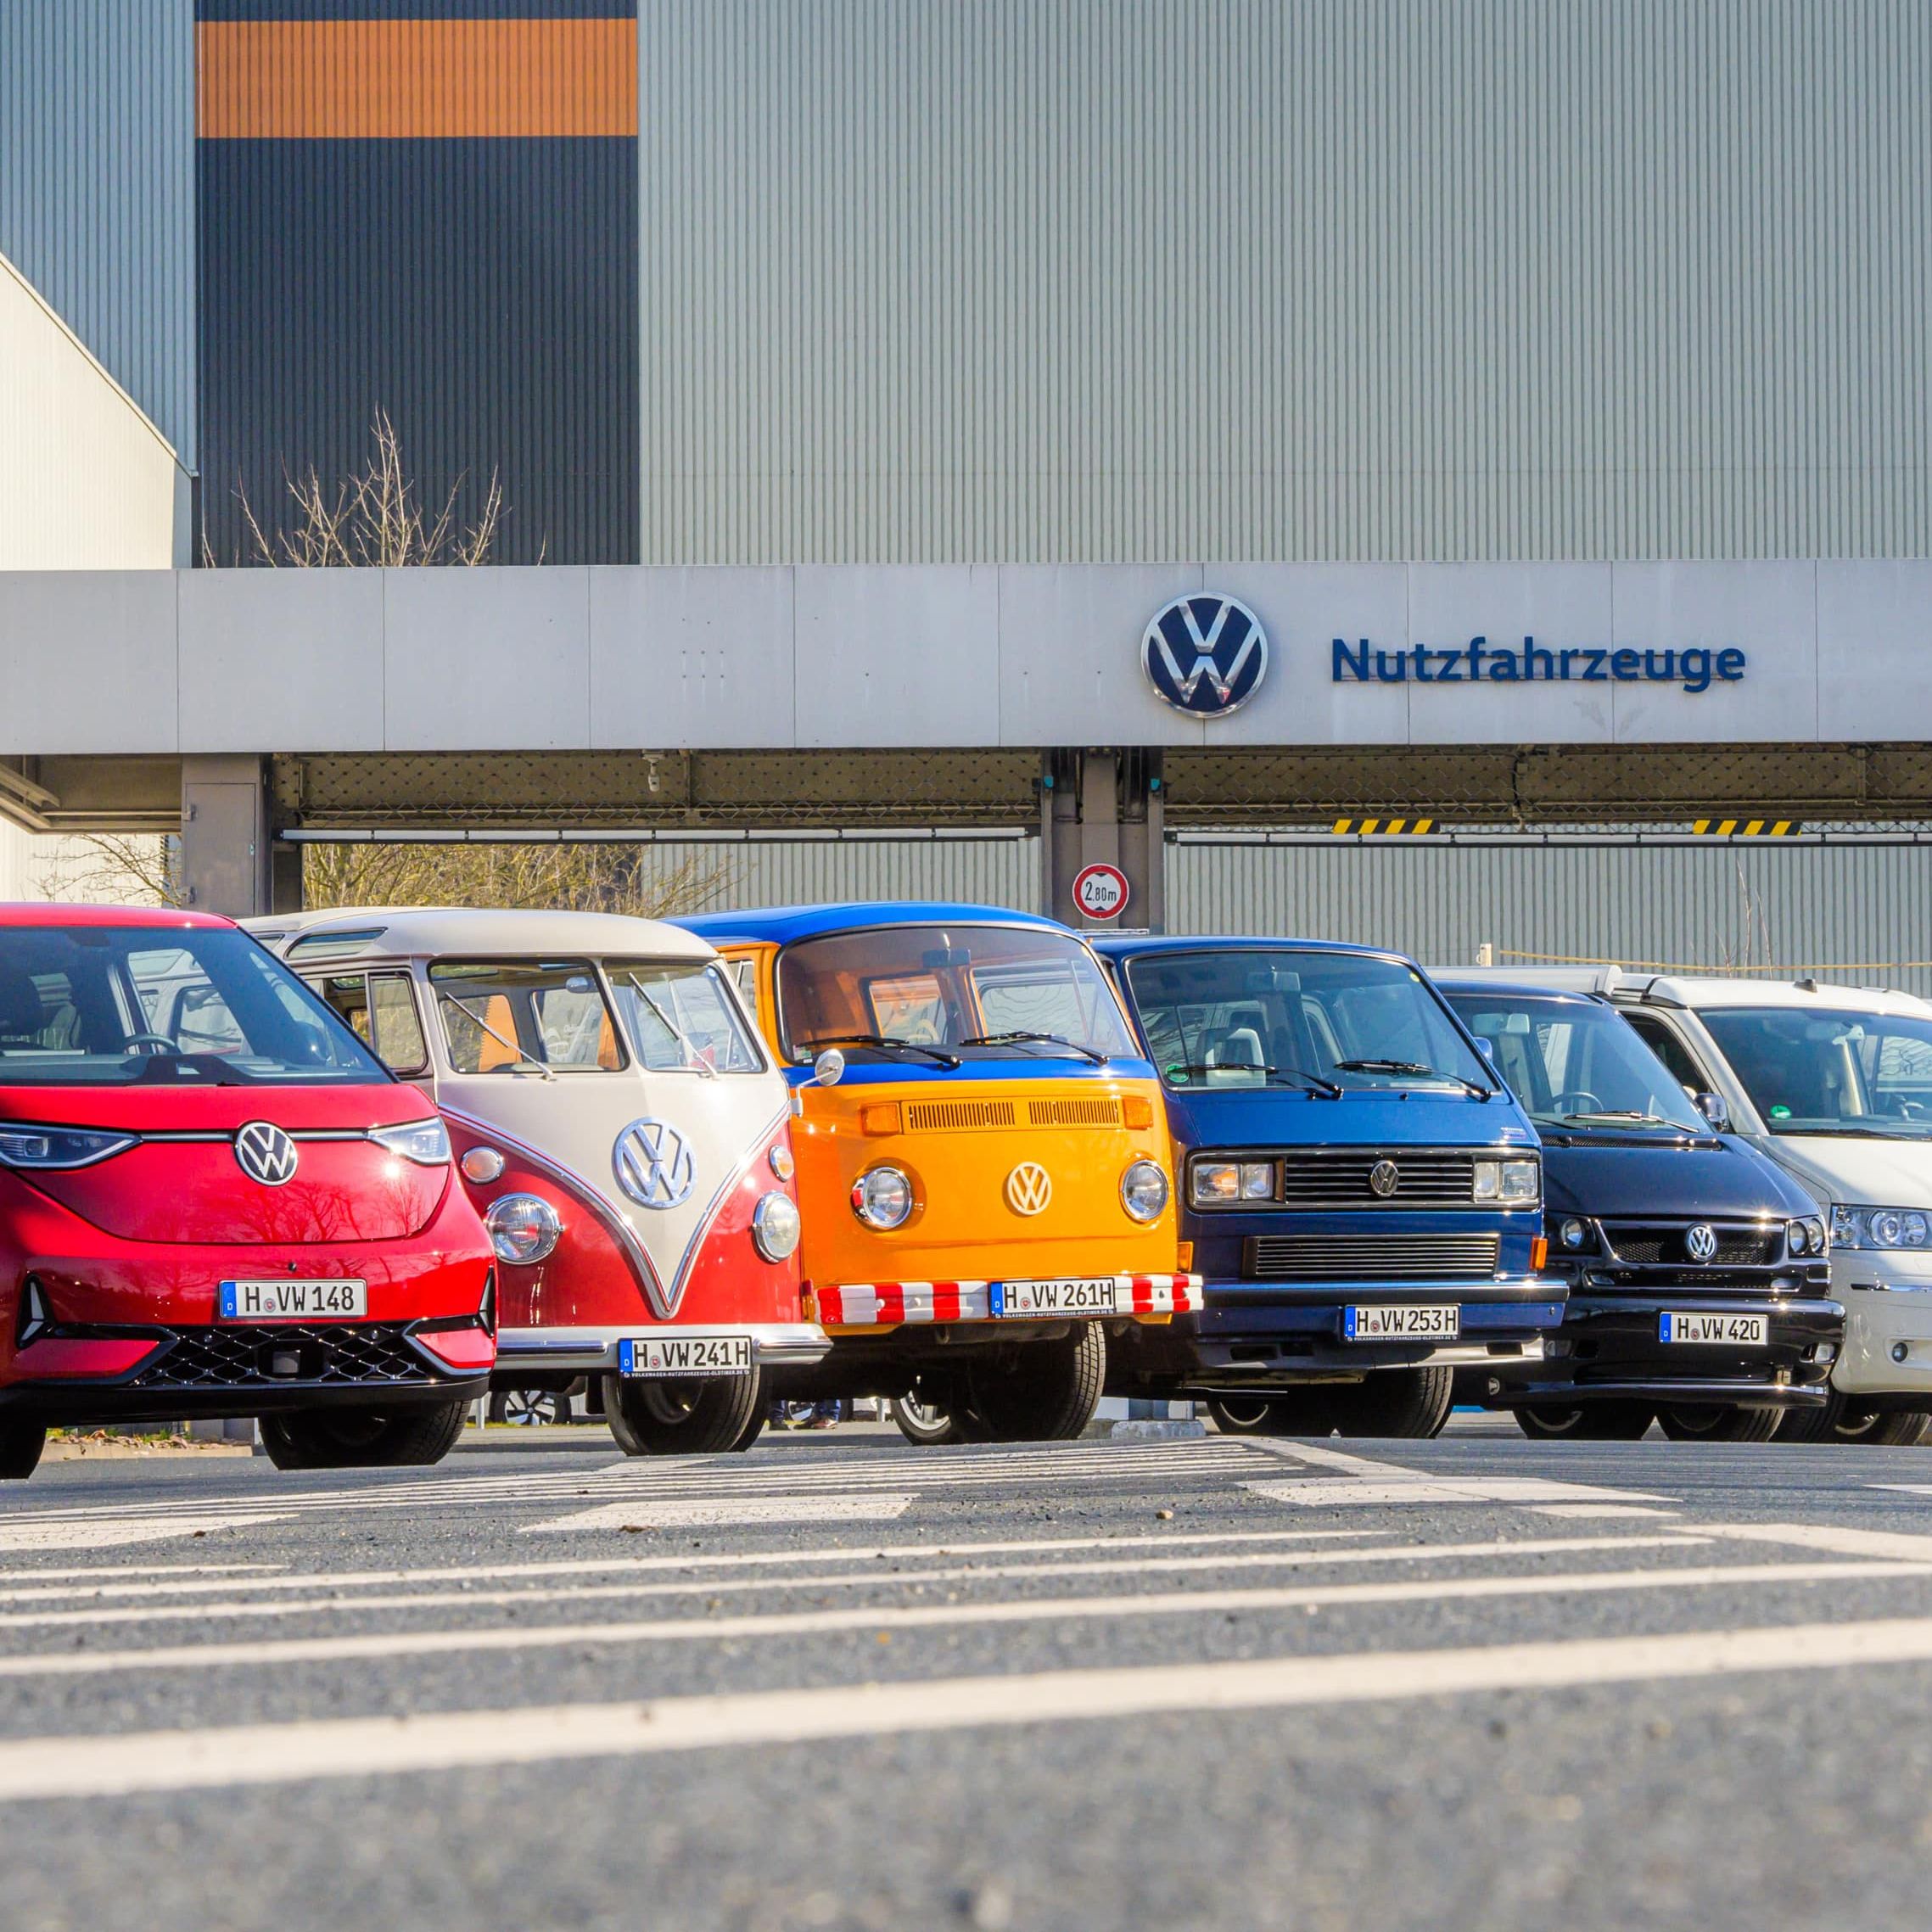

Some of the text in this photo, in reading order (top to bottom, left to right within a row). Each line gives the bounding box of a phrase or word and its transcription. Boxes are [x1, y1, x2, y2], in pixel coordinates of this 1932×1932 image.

[1143, 596, 1745, 710] VW Nutzfahrzeuge
[238, 1125, 294, 1180] VW
[619, 1120, 696, 1205] VW
[1009, 1163, 1050, 1213] VW
[245, 1286, 260, 1312] H
[312, 1286, 354, 1311] 148
[1004, 1285, 1016, 1308] H
[1357, 1310, 1369, 1332] H
[1677, 1318, 1689, 1339] H
[1728, 1319, 1760, 1341] 420
[634, 1343, 647, 1368] H
